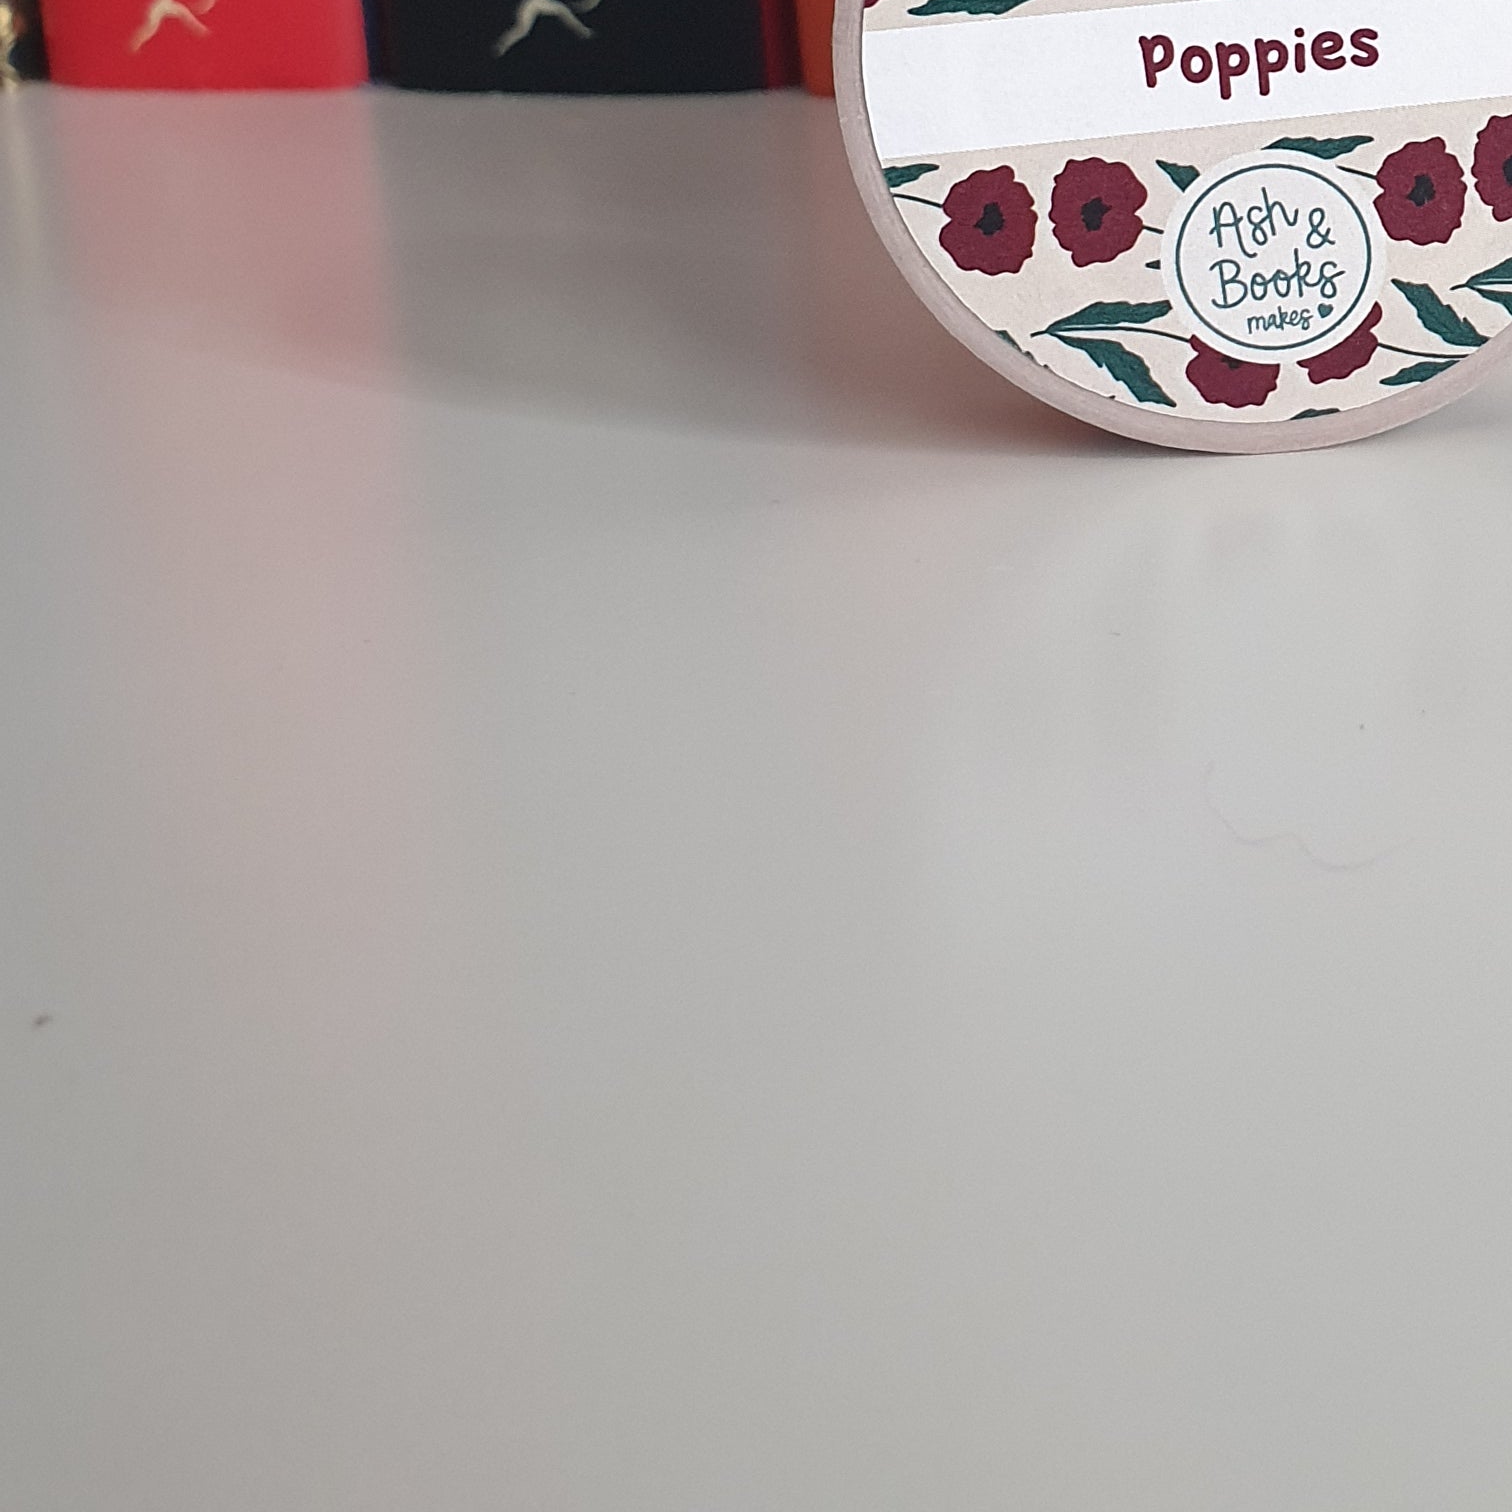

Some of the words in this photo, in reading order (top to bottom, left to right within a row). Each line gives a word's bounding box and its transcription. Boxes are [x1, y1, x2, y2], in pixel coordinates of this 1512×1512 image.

[1139, 27, 1380, 99] Poppies
[1209, 186, 1298, 258] Ash
[1306, 207, 1335, 248] &
[1209, 248, 1345, 308] Books
[1247, 305, 1313, 334] makes
